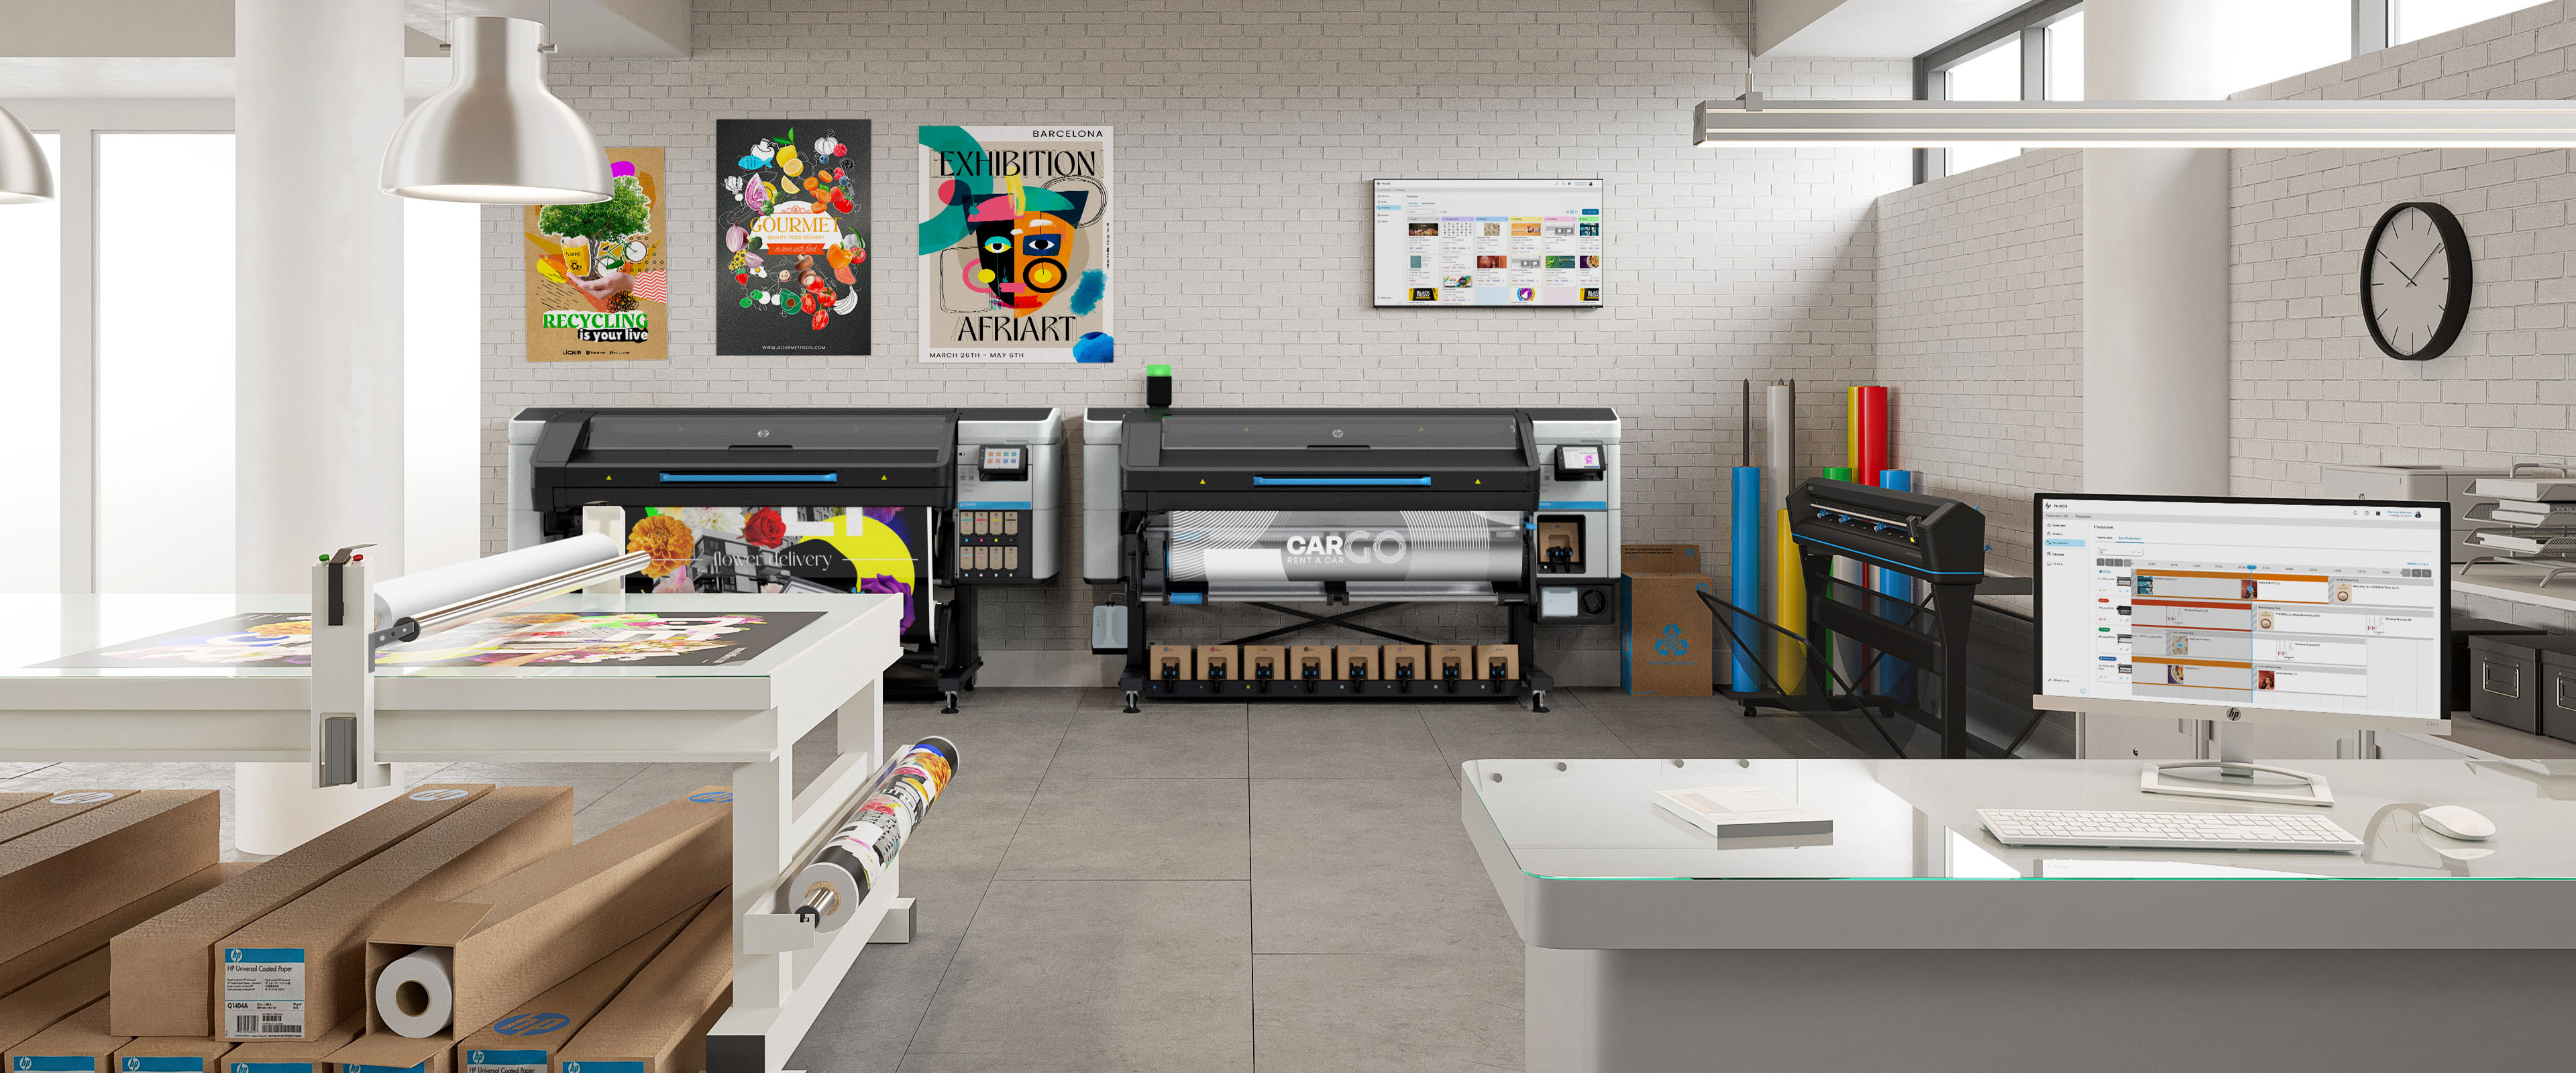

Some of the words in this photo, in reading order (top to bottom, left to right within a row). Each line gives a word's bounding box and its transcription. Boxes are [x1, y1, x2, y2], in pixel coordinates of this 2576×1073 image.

[1032, 129, 1104, 137] BARCELONA
[940, 150, 1095, 176] EXHIBITION
[749, 217, 843, 233] GOURMET
[782, 245, 793, 253] love
[793, 245, 804, 253] with
[802, 244, 817, 254] food
[543, 313, 649, 329] RECYCLING
[957, 316, 1076, 341] AFRIART
[580, 329, 590, 340] is
[592, 331, 623, 343] your
[625, 329, 648, 340] live
[758, 429, 769, 438] hp
[1332, 429, 1344, 439] hp
[1286, 530, 1407, 565] CARGO
[713, 551, 763, 567] flower
[769, 551, 833, 571] delivery
[2226, 706, 2241, 722] hp
[231, 949, 242, 962] hp
[278, 966, 293, 974] Paper
[494, 1013, 570, 1036] hp
[19, 1056, 32, 1071] hp
[128, 1057, 140, 1072] hp
[472, 1050, 484, 1065] hp
[237, 1062, 249, 1073] hp
[568, 1062, 580, 1073] hp
